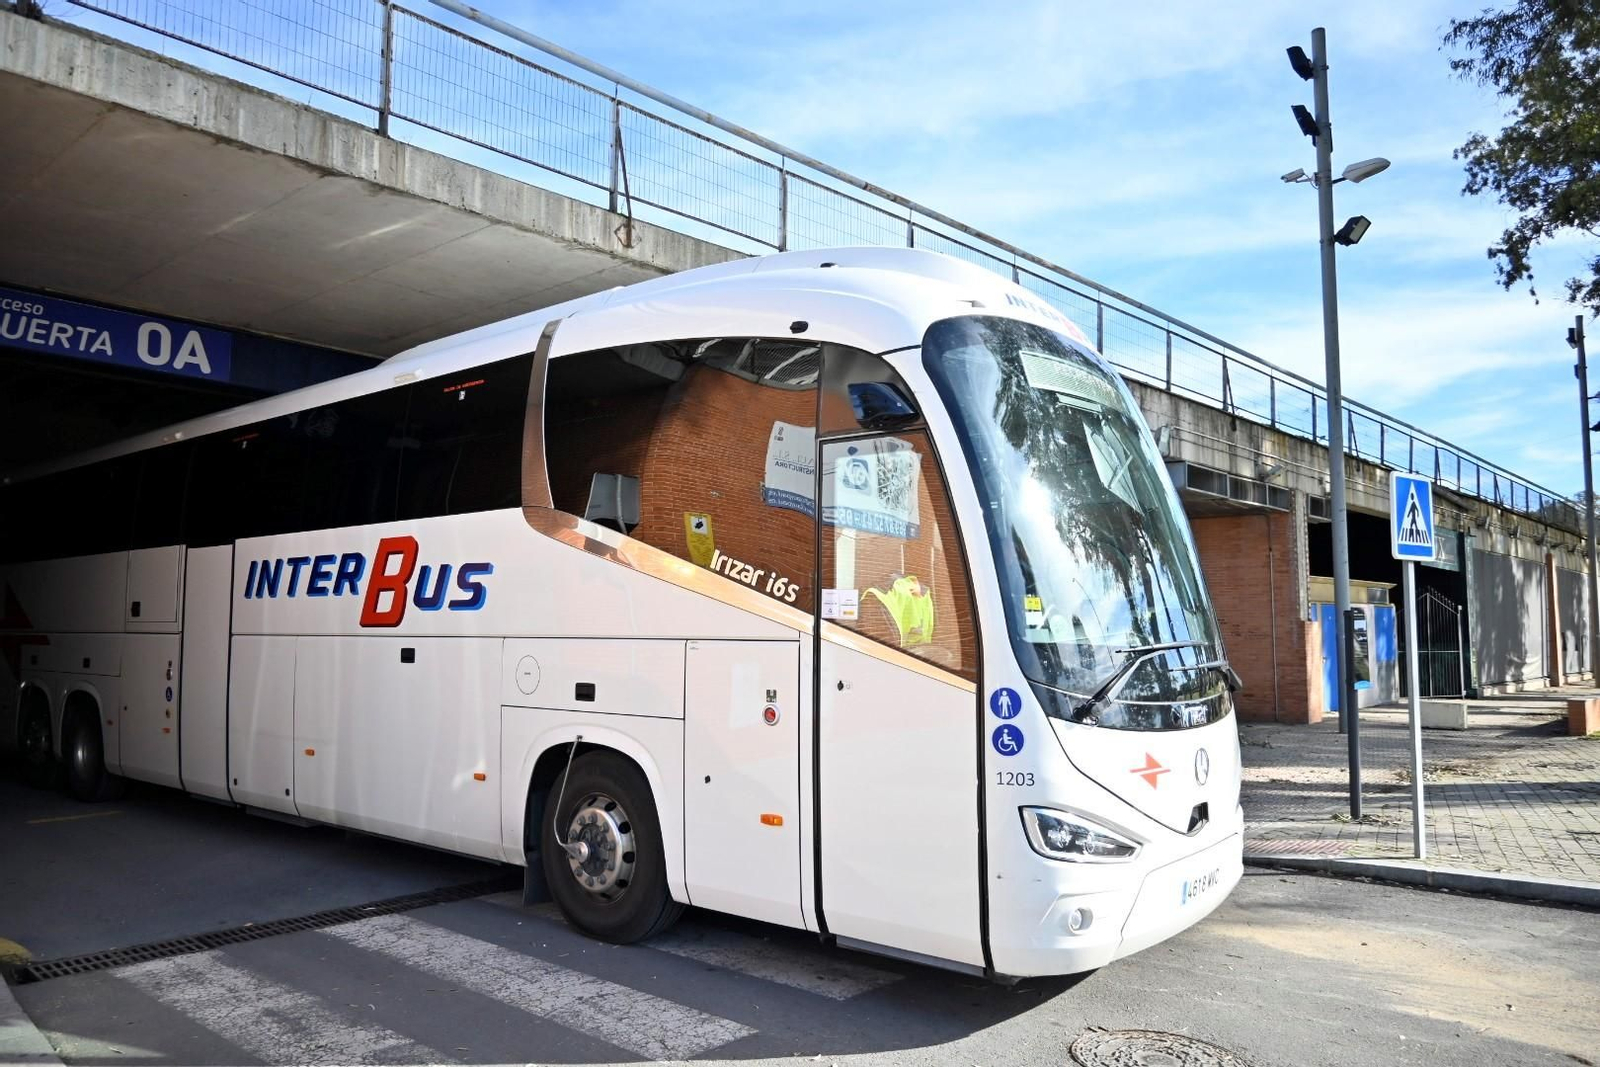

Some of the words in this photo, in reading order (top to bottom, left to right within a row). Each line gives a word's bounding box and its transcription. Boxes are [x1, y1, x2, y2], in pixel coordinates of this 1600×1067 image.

[0, 297, 44, 316] ceso
[0, 312, 113, 357] UERTA
[244, 535, 495, 628] INTERBUS
[709, 549, 765, 587] Irizar
[765, 571, 800, 603] i6s
[996, 771, 1035, 787] 1203
